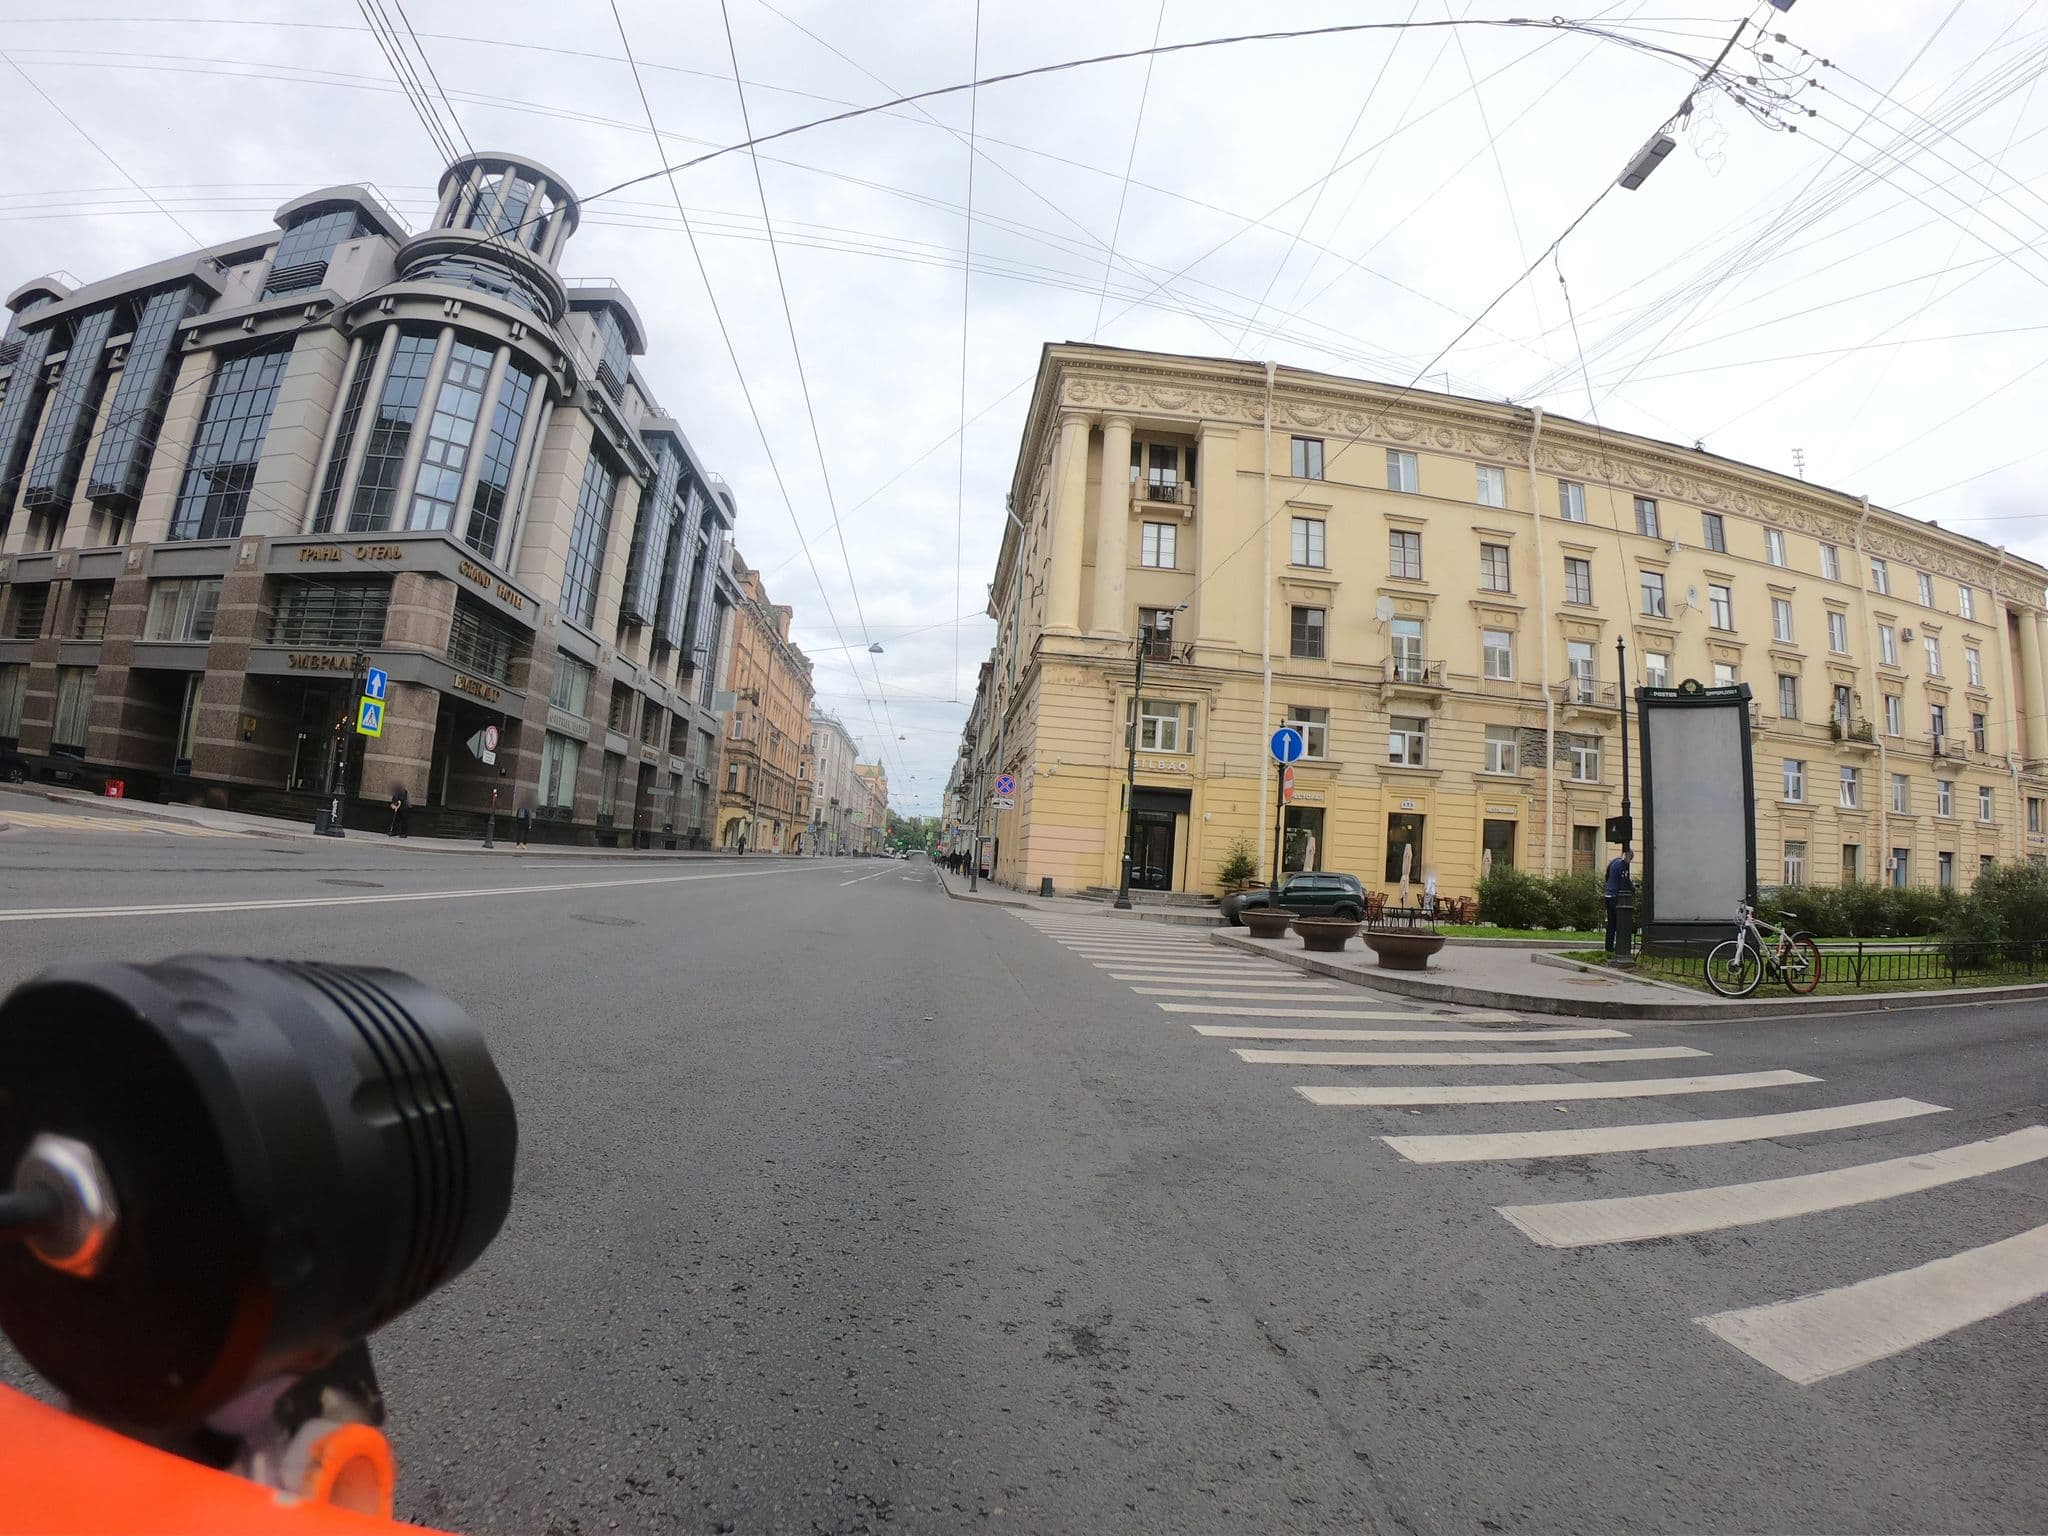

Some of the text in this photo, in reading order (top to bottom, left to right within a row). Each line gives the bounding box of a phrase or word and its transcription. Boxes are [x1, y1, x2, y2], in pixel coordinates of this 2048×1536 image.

[297, 544, 402, 562] ГРАНД ОТЕЛЬ
[458, 560, 524, 610] GRAND HOTEL
[1133, 759, 1187, 771] BILBAO
